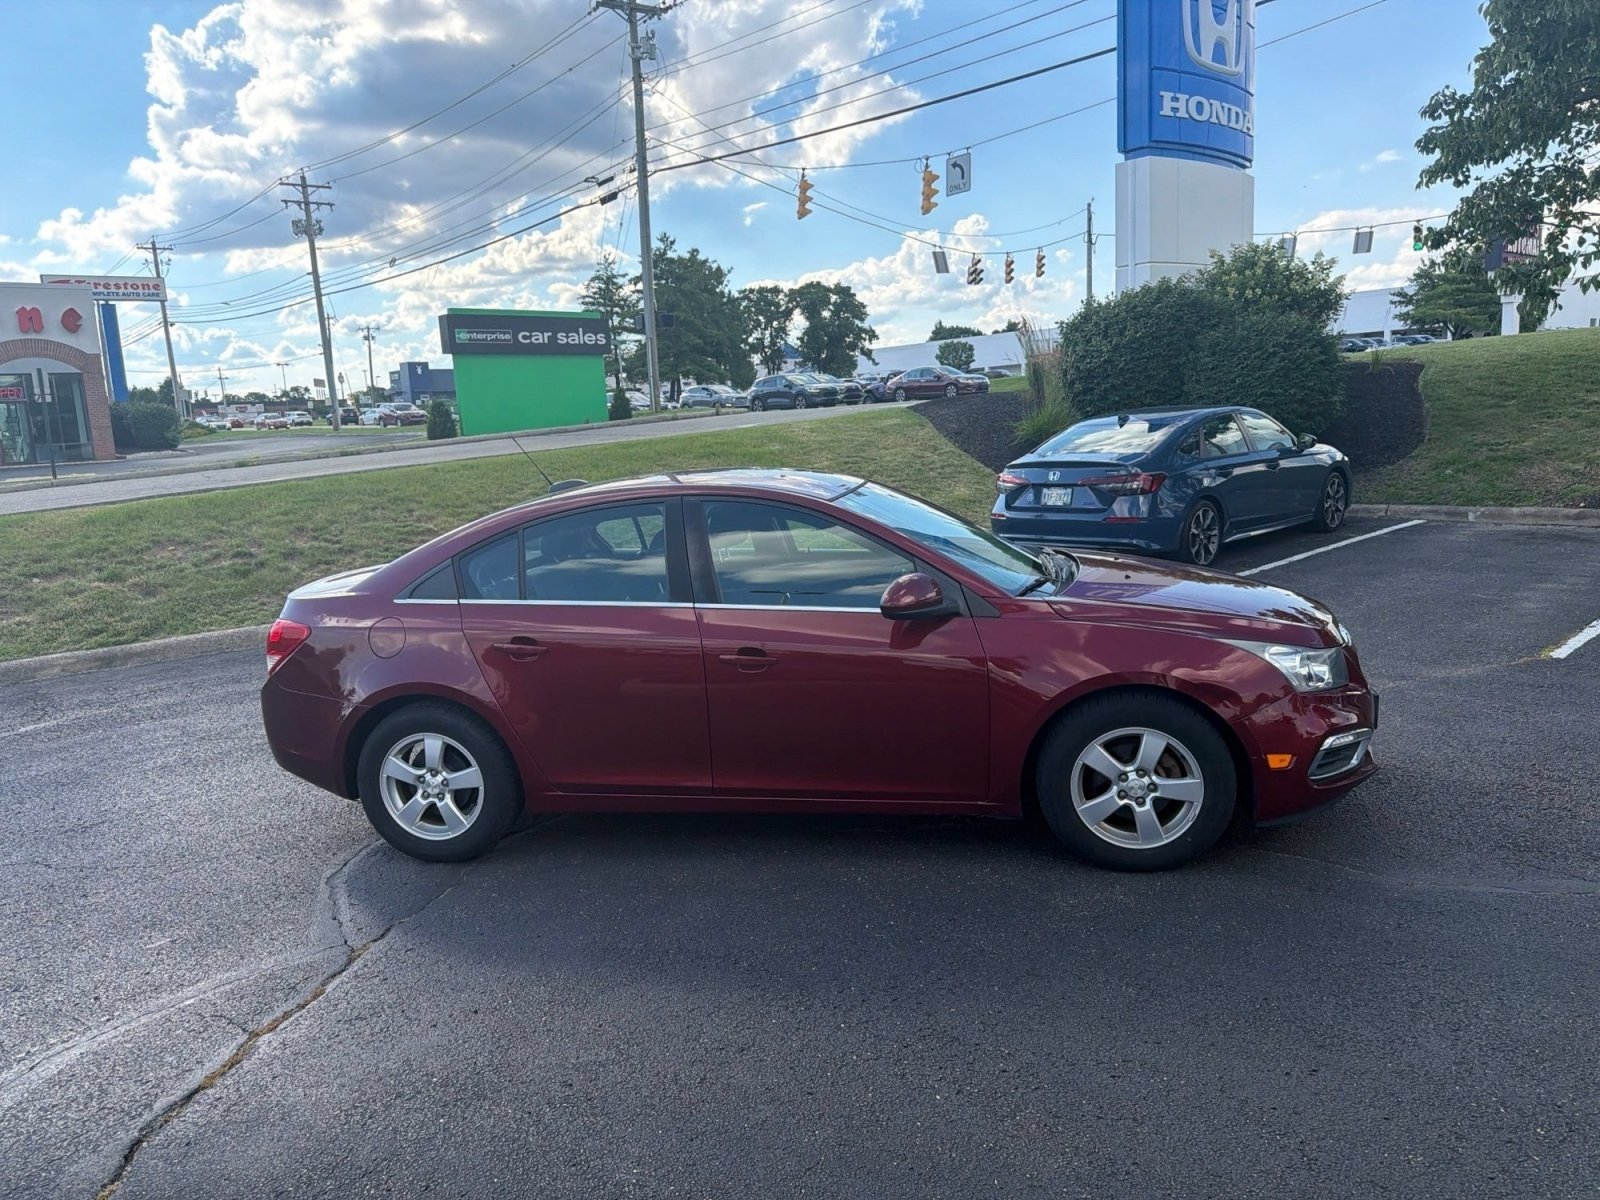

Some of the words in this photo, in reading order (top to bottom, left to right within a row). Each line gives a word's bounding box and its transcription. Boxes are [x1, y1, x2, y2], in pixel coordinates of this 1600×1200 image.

[1160, 91, 1254, 137] HONDA
[949, 182, 967, 192] ONLY
[459, 332, 512, 341] enterprise
[518, 331, 552, 343] car
[557, 328, 607, 345] sales
[0, 388, 22, 398] PEN
